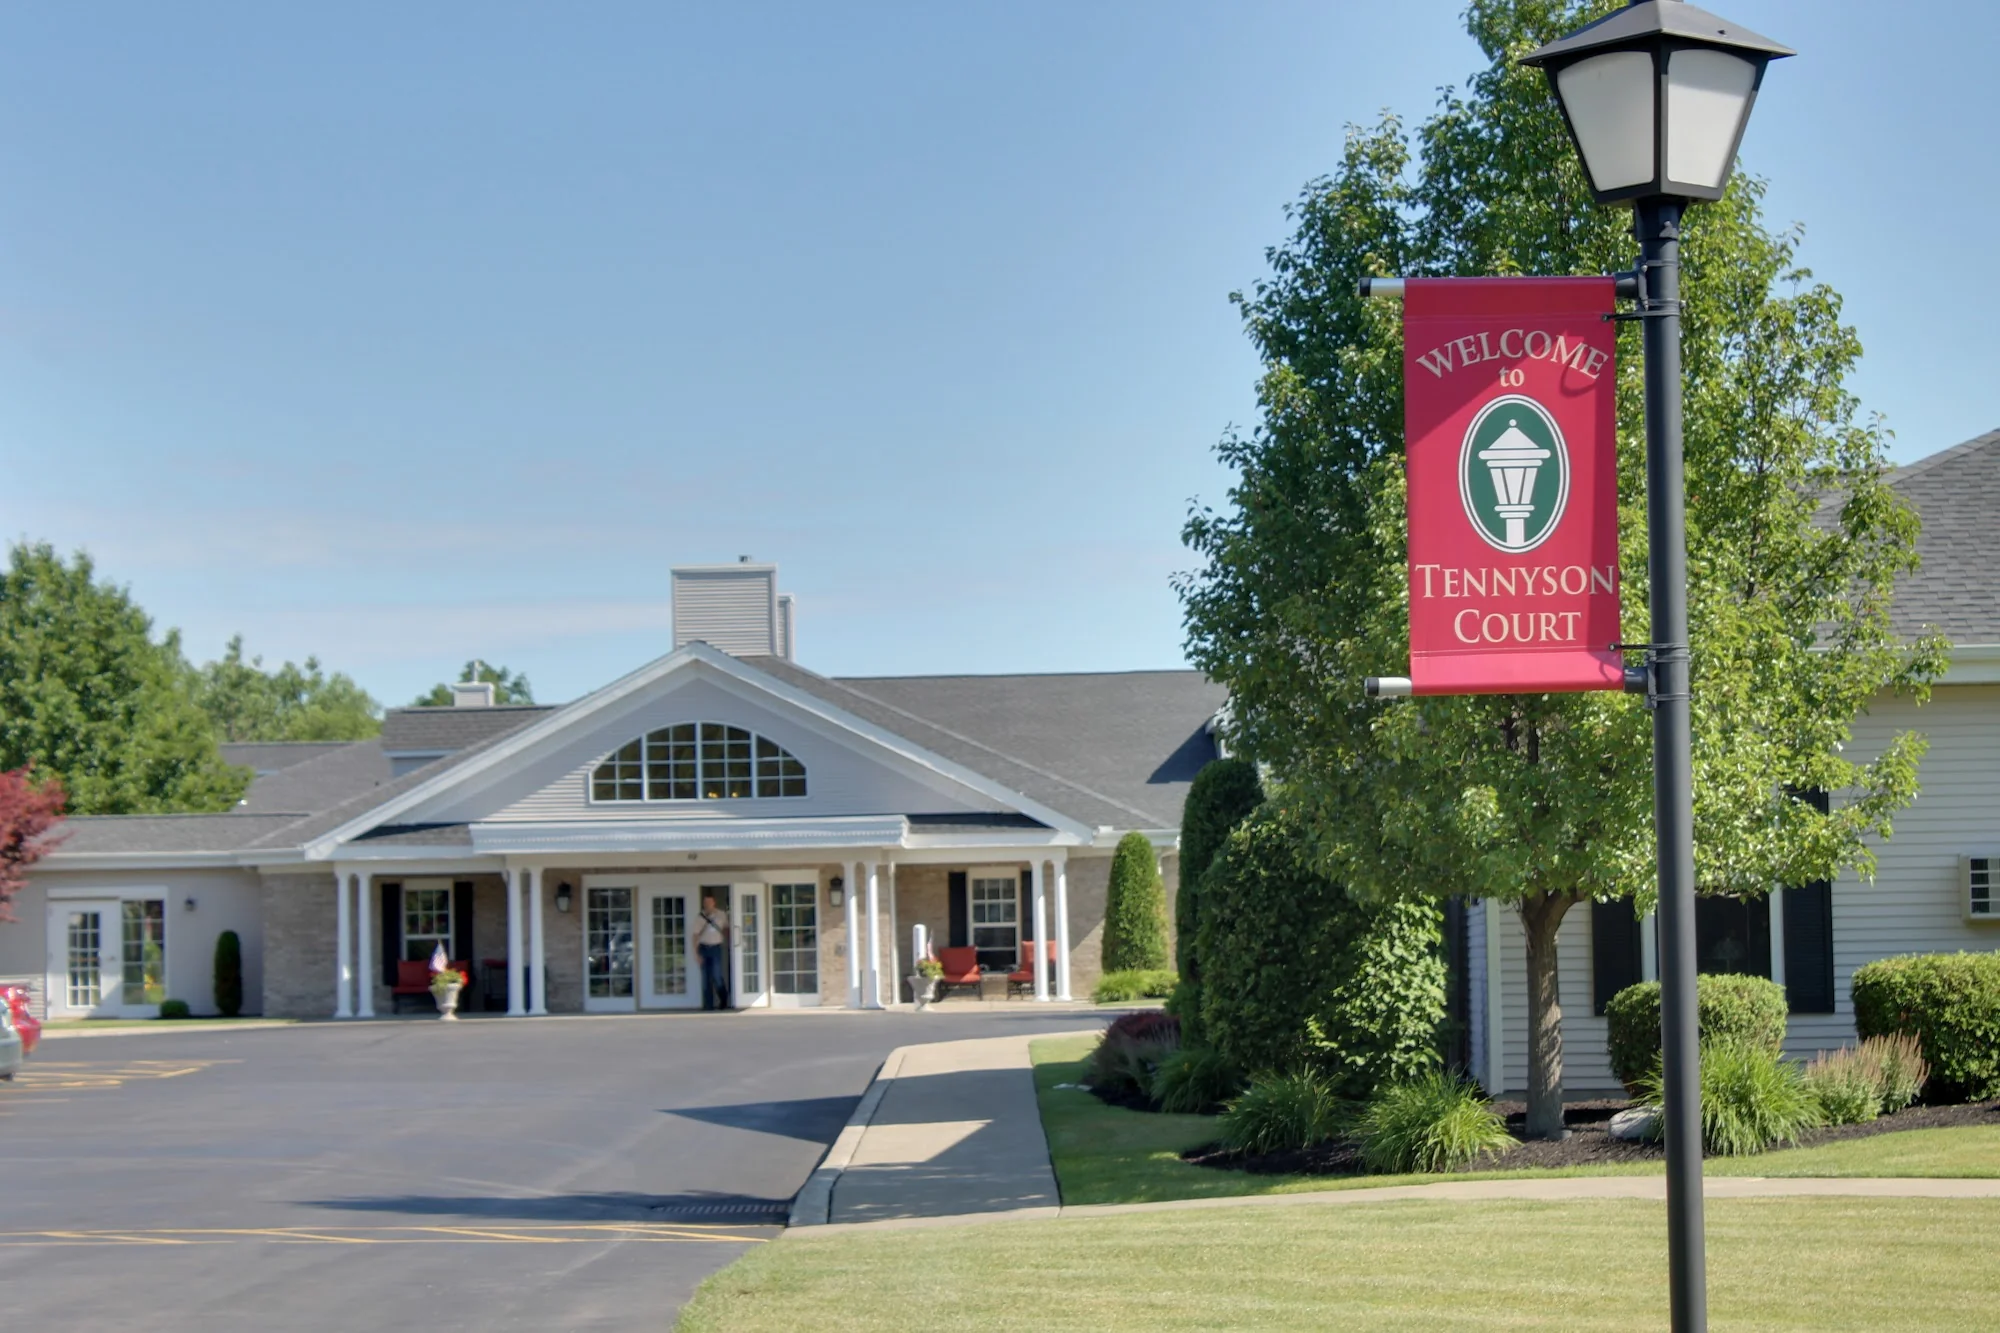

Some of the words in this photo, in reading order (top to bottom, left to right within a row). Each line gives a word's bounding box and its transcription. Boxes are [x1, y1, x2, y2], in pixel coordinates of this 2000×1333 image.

[1416, 328, 1609, 380] WELCOME
[1498, 366, 1525, 387] to
[1415, 564, 1614, 598] TENNYSON
[1454, 609, 1581, 644] COURT
